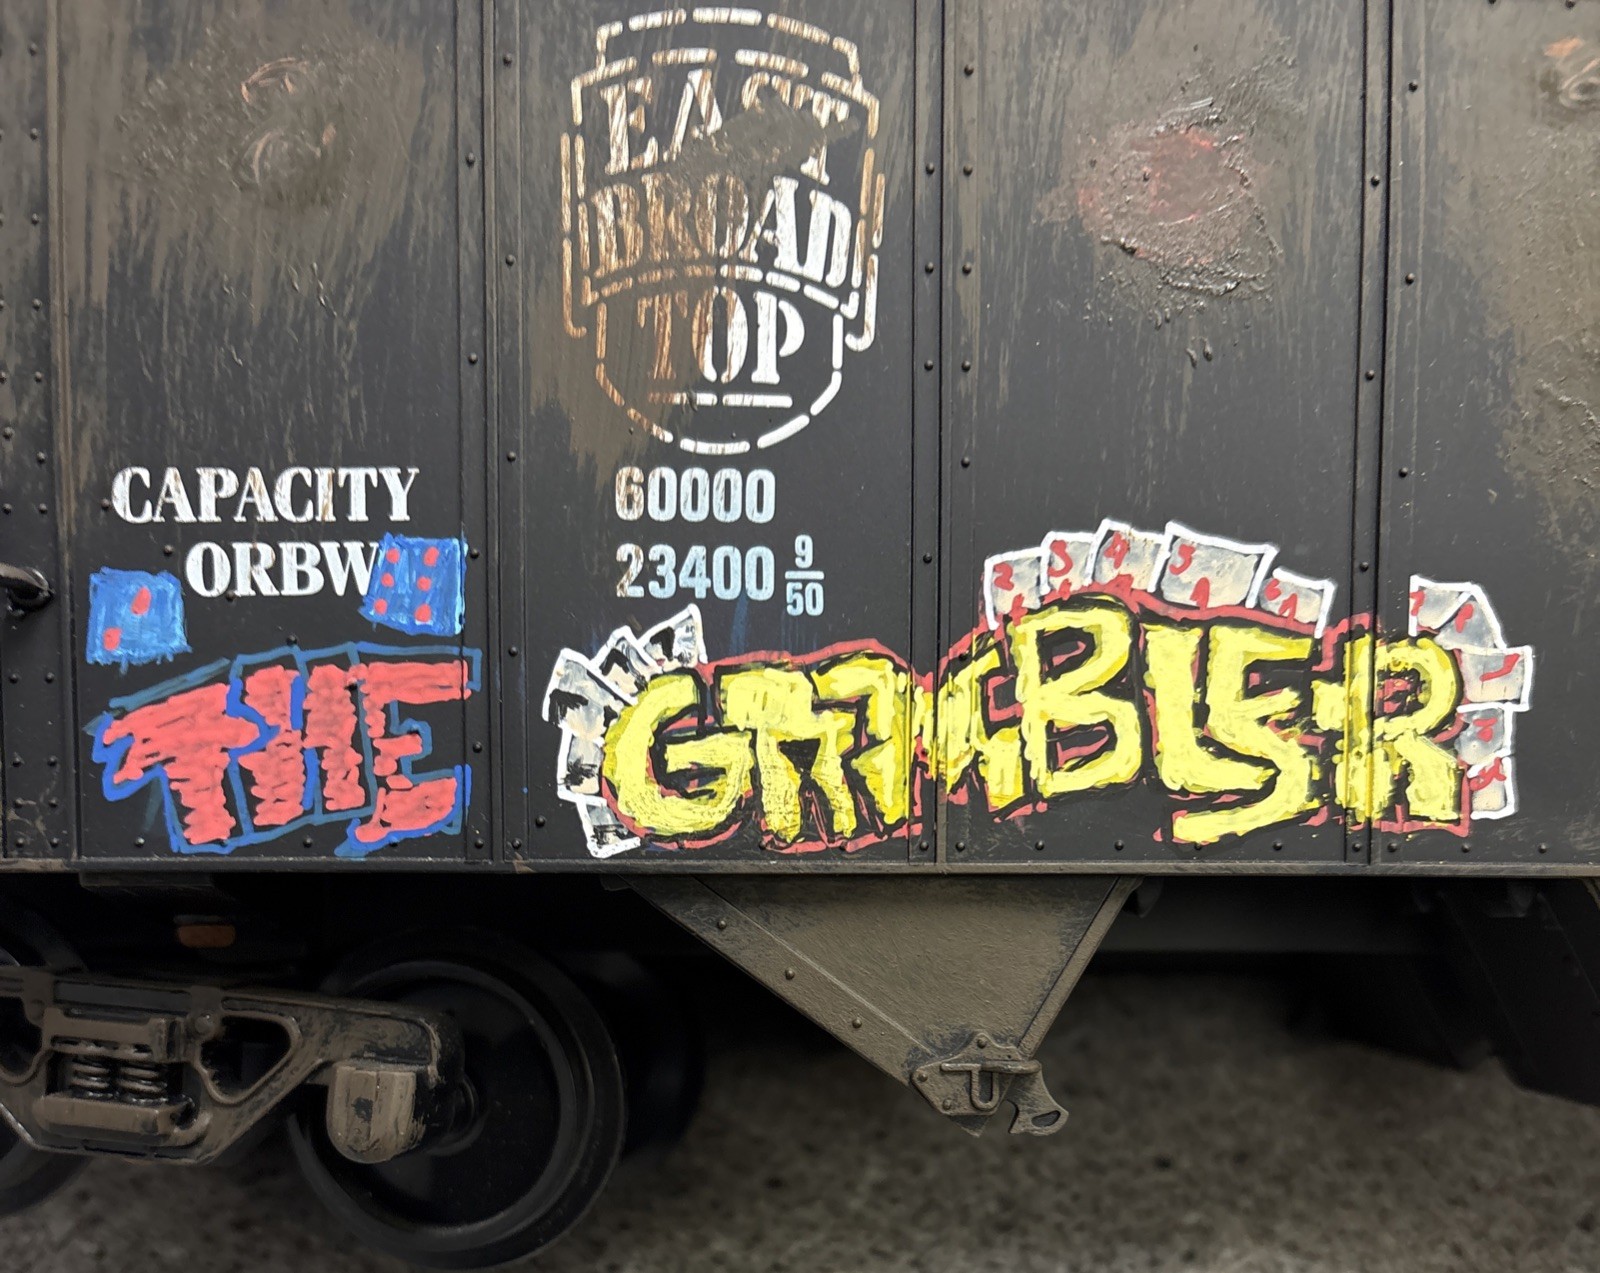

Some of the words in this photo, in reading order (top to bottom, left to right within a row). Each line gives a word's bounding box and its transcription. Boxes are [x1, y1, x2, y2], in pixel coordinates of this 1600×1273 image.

[590, 173, 852, 288] BROAD
[636, 285, 805, 385] TOP
[111, 466, 419, 524] CAPACITY
[615, 466, 776, 524] 60000
[186, 541, 379, 597] ORBW
[616, 543, 775, 601] 23400
[88, 644, 480, 852] THE
[602, 592, 1468, 848] GAMBLER
